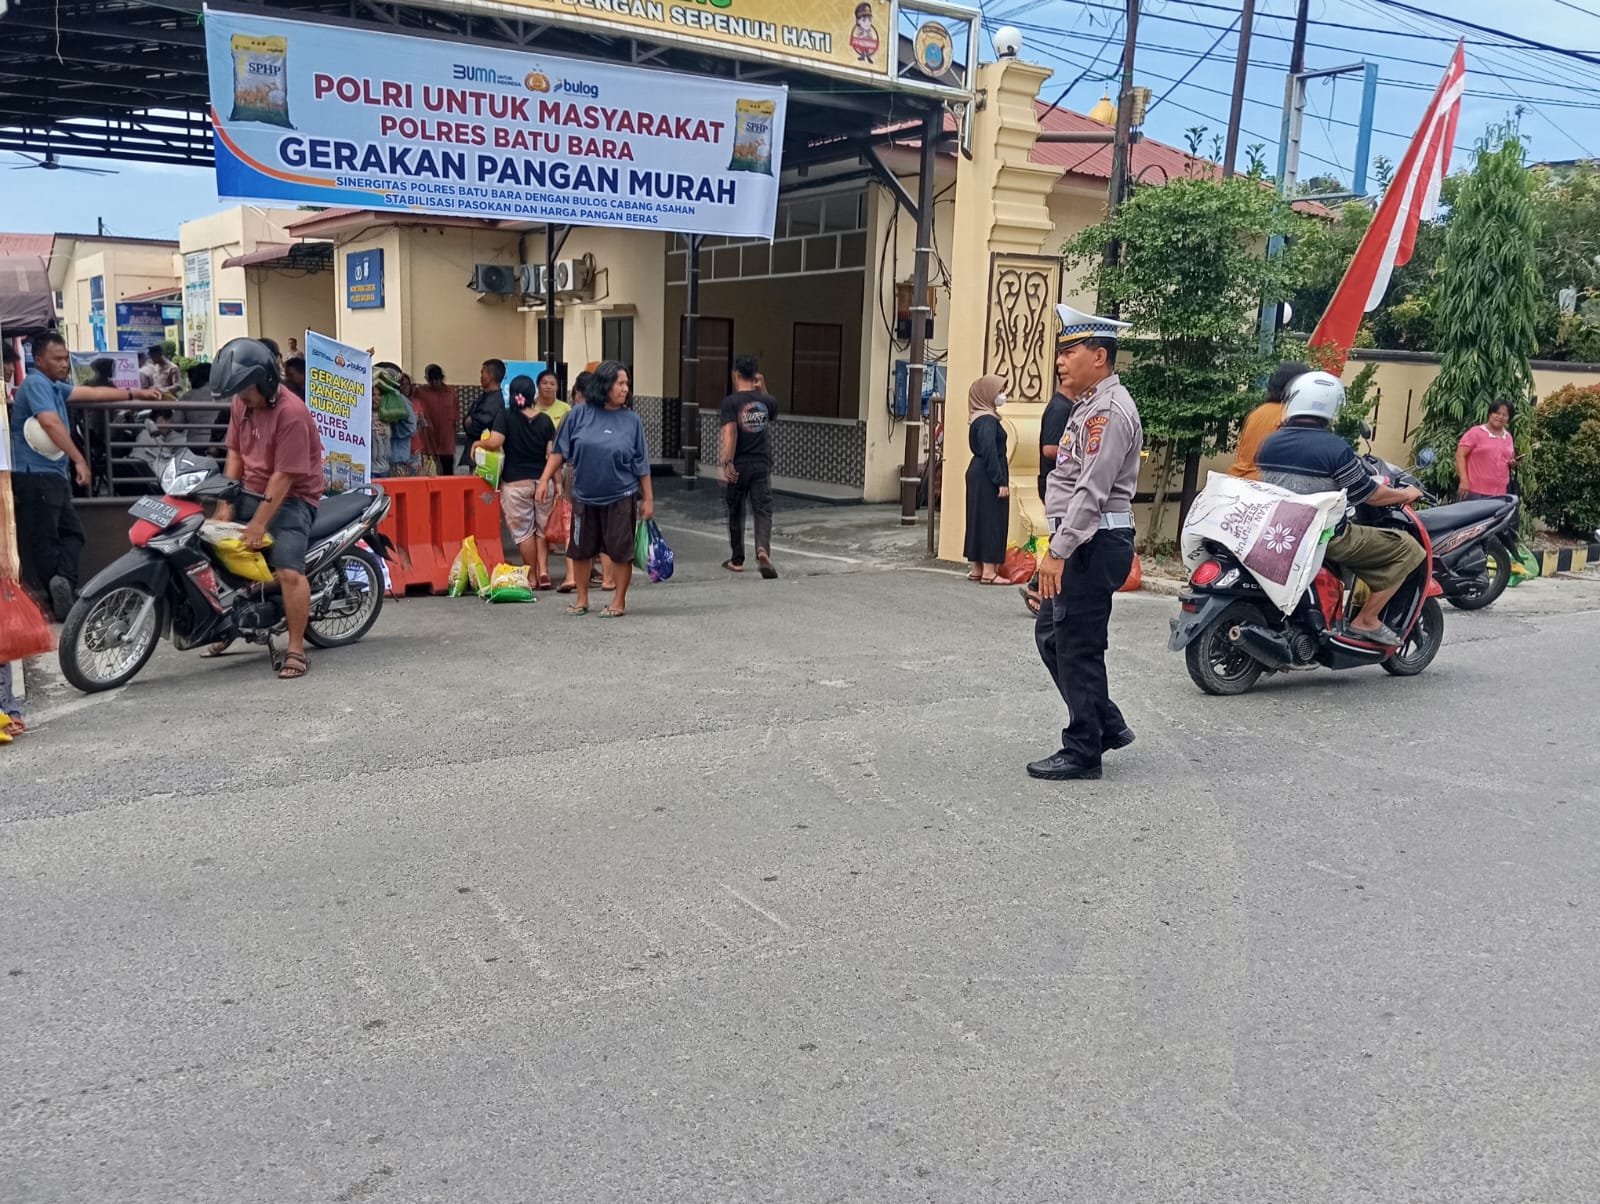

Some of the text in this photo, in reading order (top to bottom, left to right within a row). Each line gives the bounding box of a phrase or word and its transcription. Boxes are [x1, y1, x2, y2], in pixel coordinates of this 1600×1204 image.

[562, 0, 663, 22] ENGAN
[670, 5, 776, 42] SEPENUH
[783, 25, 831, 53] HATI
[248, 62, 281, 76] SPHP
[563, 78, 599, 98] bulog
[314, 73, 724, 143] POLRI UNTUK MASYARAKAT
[381, 115, 634, 161] POLRES BATU BARA
[746, 121, 768, 134] SPHP
[279, 137, 736, 205] GERAKAN PANGAN MURAH
[336, 176, 695, 215] SINERGITAS POLRES BATU BARA DENGAN BULOG CABANG ASAHAN
[384, 193, 658, 223] STABILISASI PASOKAN DAN HARGA PANGAN BERAS
[309, 367, 365, 397] GERAKAN
[309, 381, 358, 407] PANGAN
[310, 394, 351, 418] MURAH
[316, 424, 366, 447] ATU BARA
